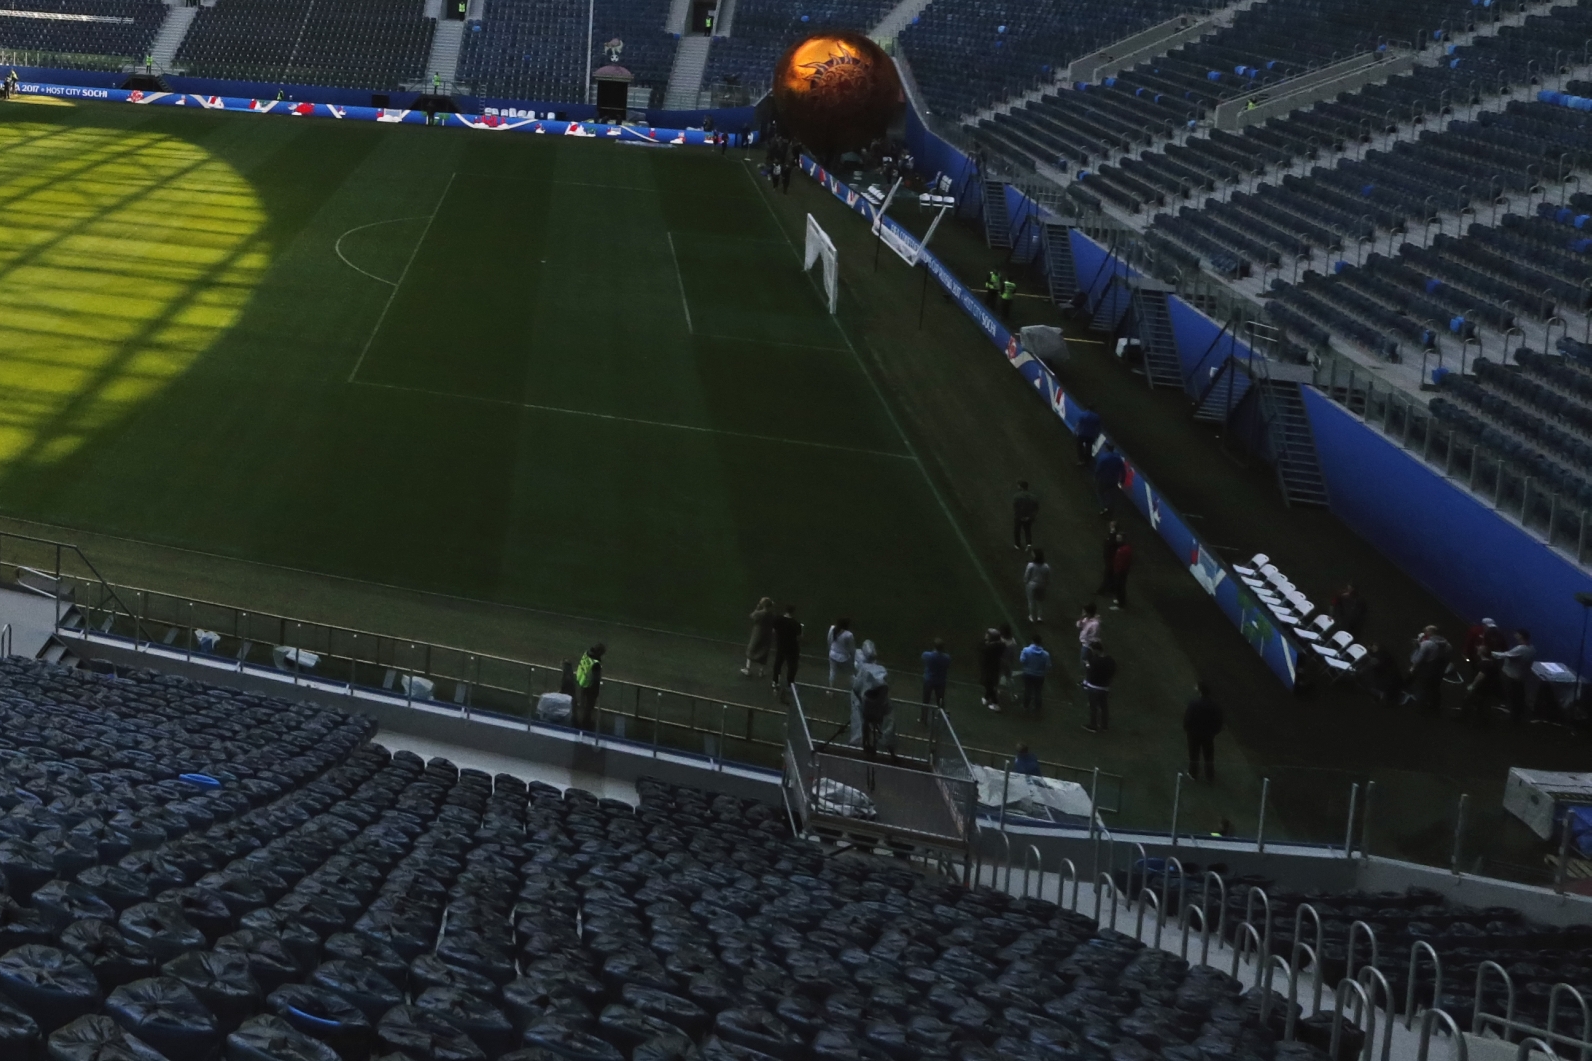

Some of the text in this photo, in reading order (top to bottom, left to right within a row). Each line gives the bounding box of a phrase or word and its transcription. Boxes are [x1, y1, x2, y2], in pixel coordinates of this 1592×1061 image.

[21, 84, 40, 93] 2017
[45, 87, 64, 95] HOST
[65, 88, 81, 96] CITY
[82, 89, 108, 98] SOCHI
[981, 312, 997, 337] SOCHI
